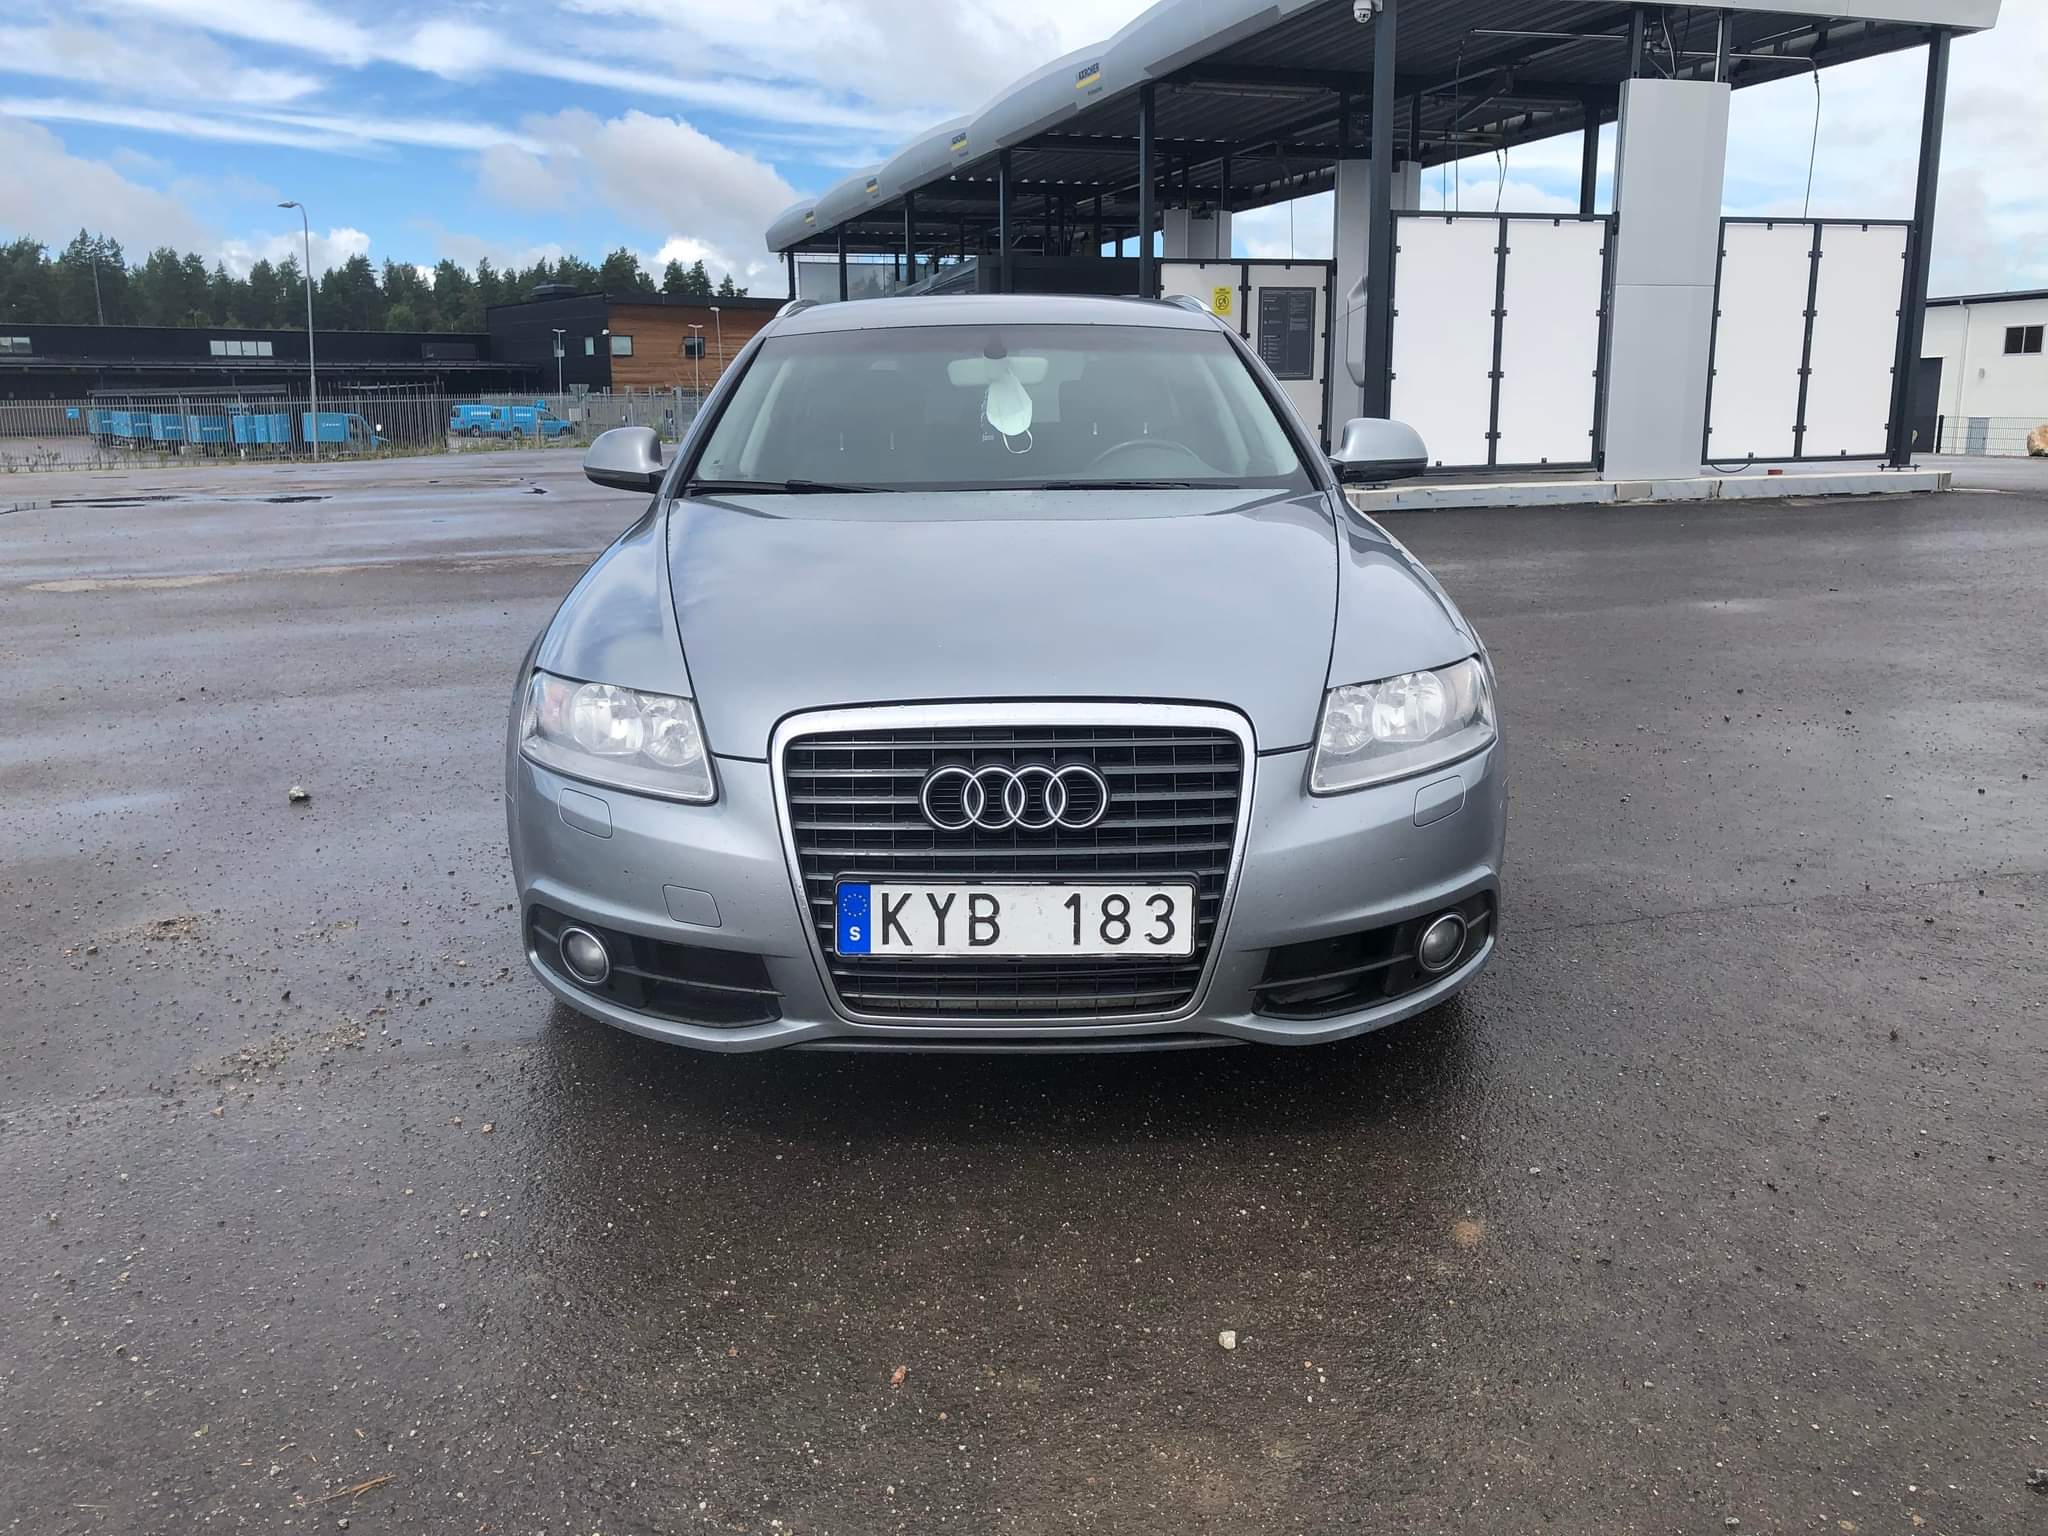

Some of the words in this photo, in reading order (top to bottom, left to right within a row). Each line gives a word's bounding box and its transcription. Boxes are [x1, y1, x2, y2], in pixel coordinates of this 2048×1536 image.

[849, 926, 861, 941] S
[881, 893, 1000, 946] KYB
[1064, 893, 1175, 945] 183
